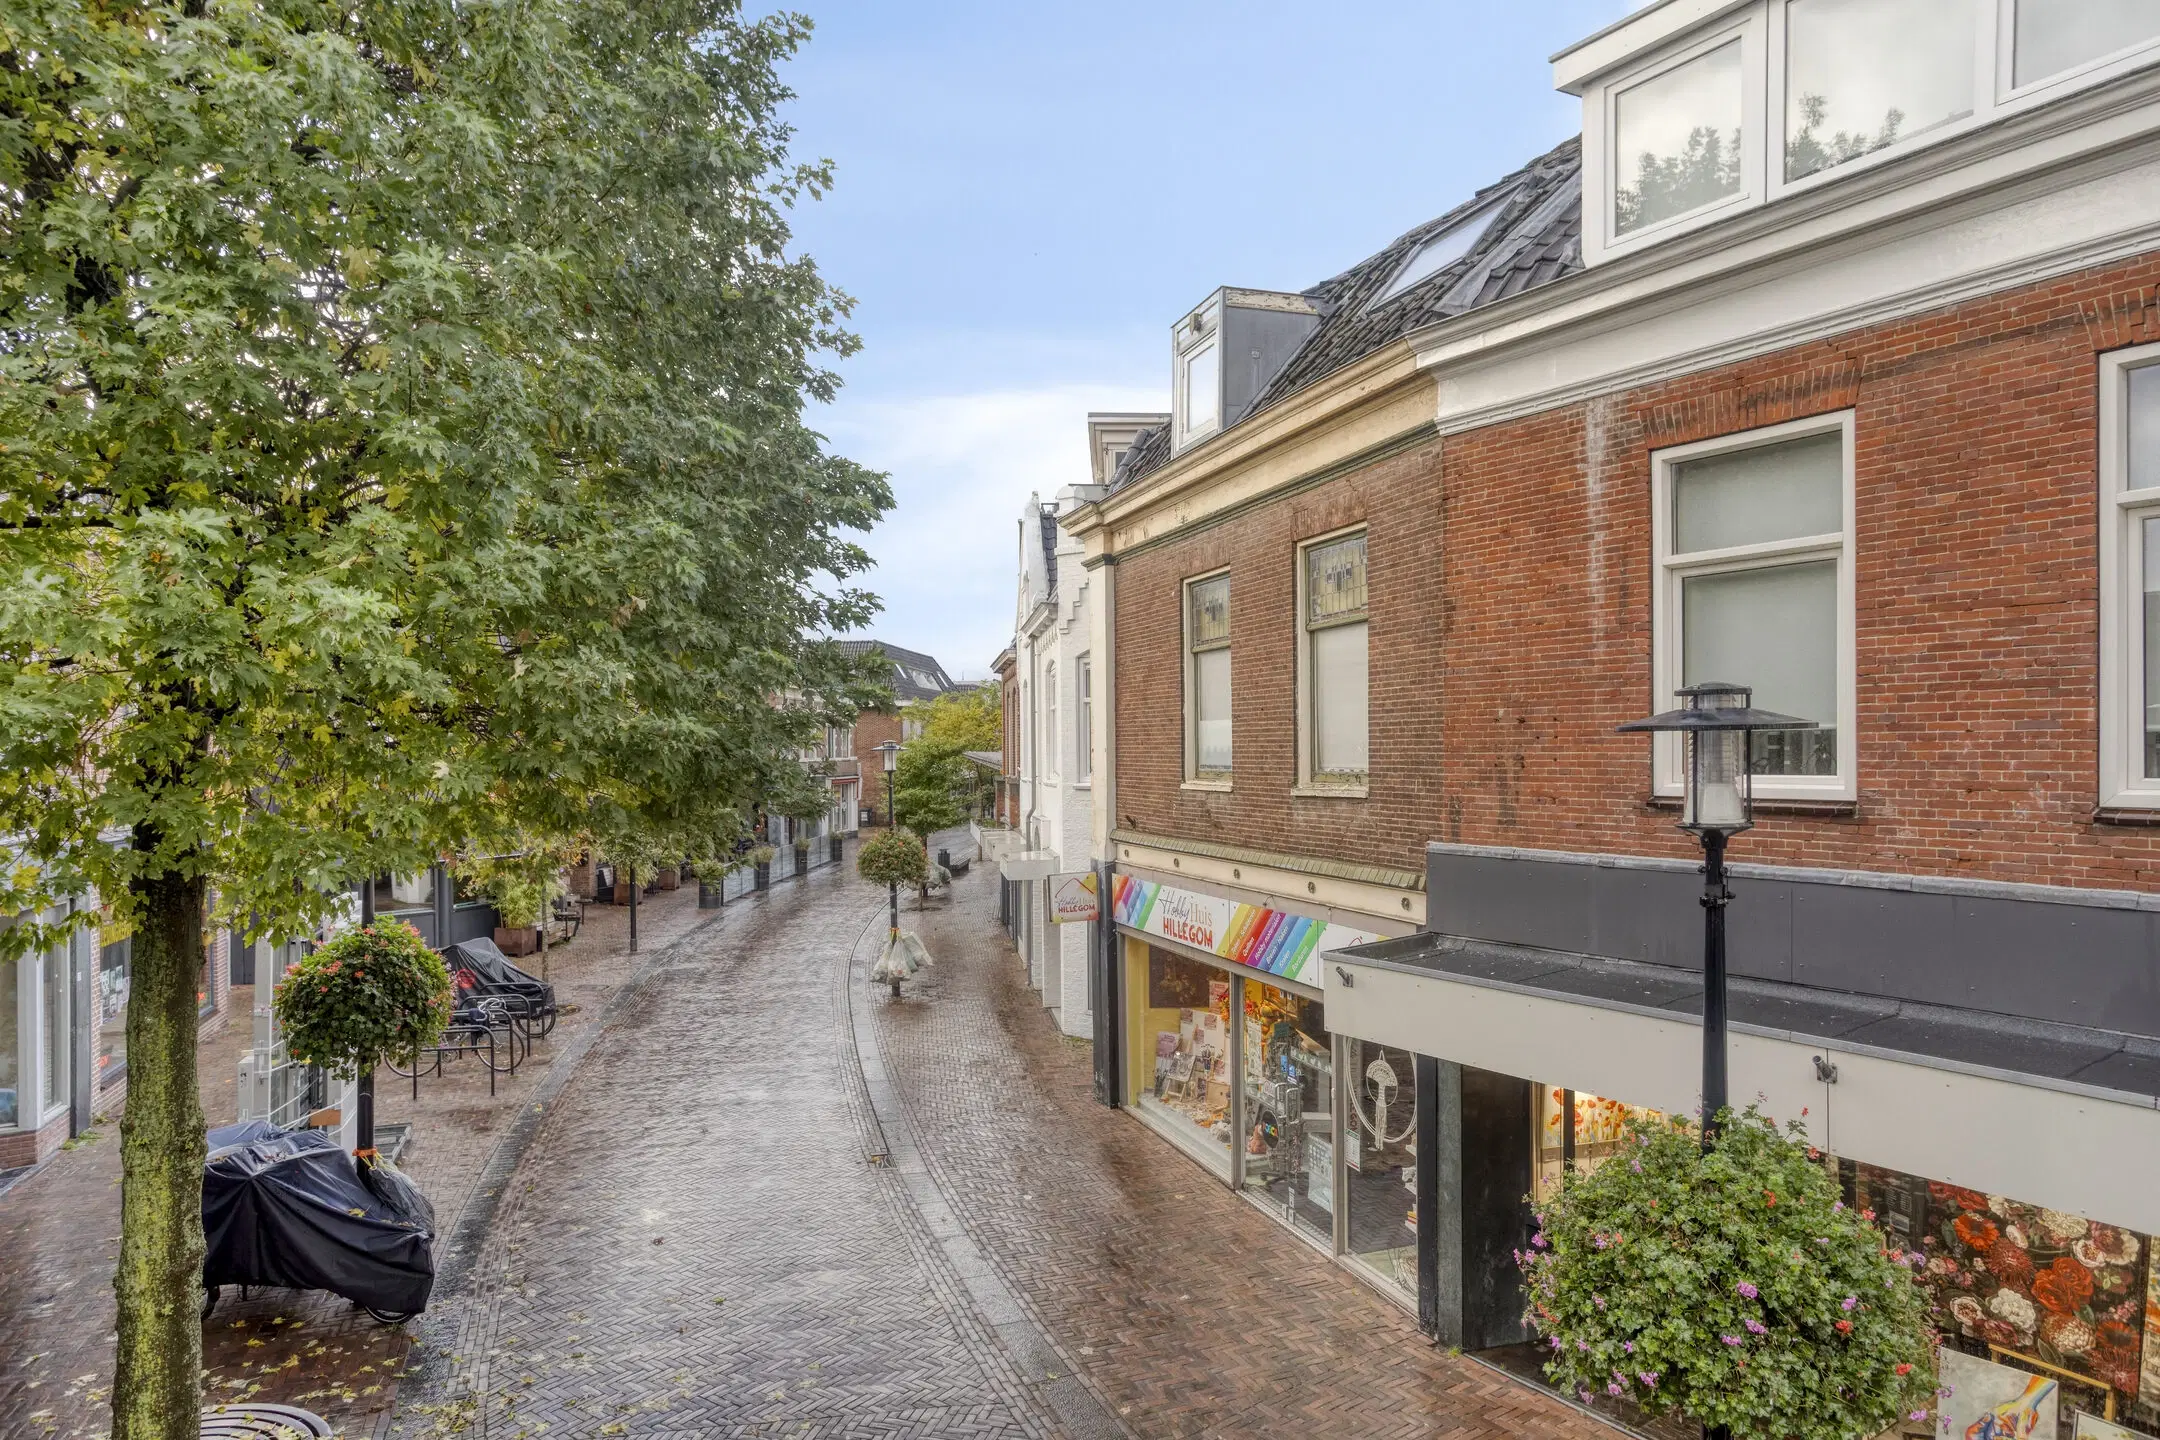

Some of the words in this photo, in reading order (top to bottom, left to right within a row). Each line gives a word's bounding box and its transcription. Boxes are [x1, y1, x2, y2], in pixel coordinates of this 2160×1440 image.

[1058, 904, 1096, 914] HILLEGOM
[1158, 890, 1190, 923] Hobby
[1190, 902, 1213, 927] Huis
[1163, 915, 1213, 950] HILLEGOM
